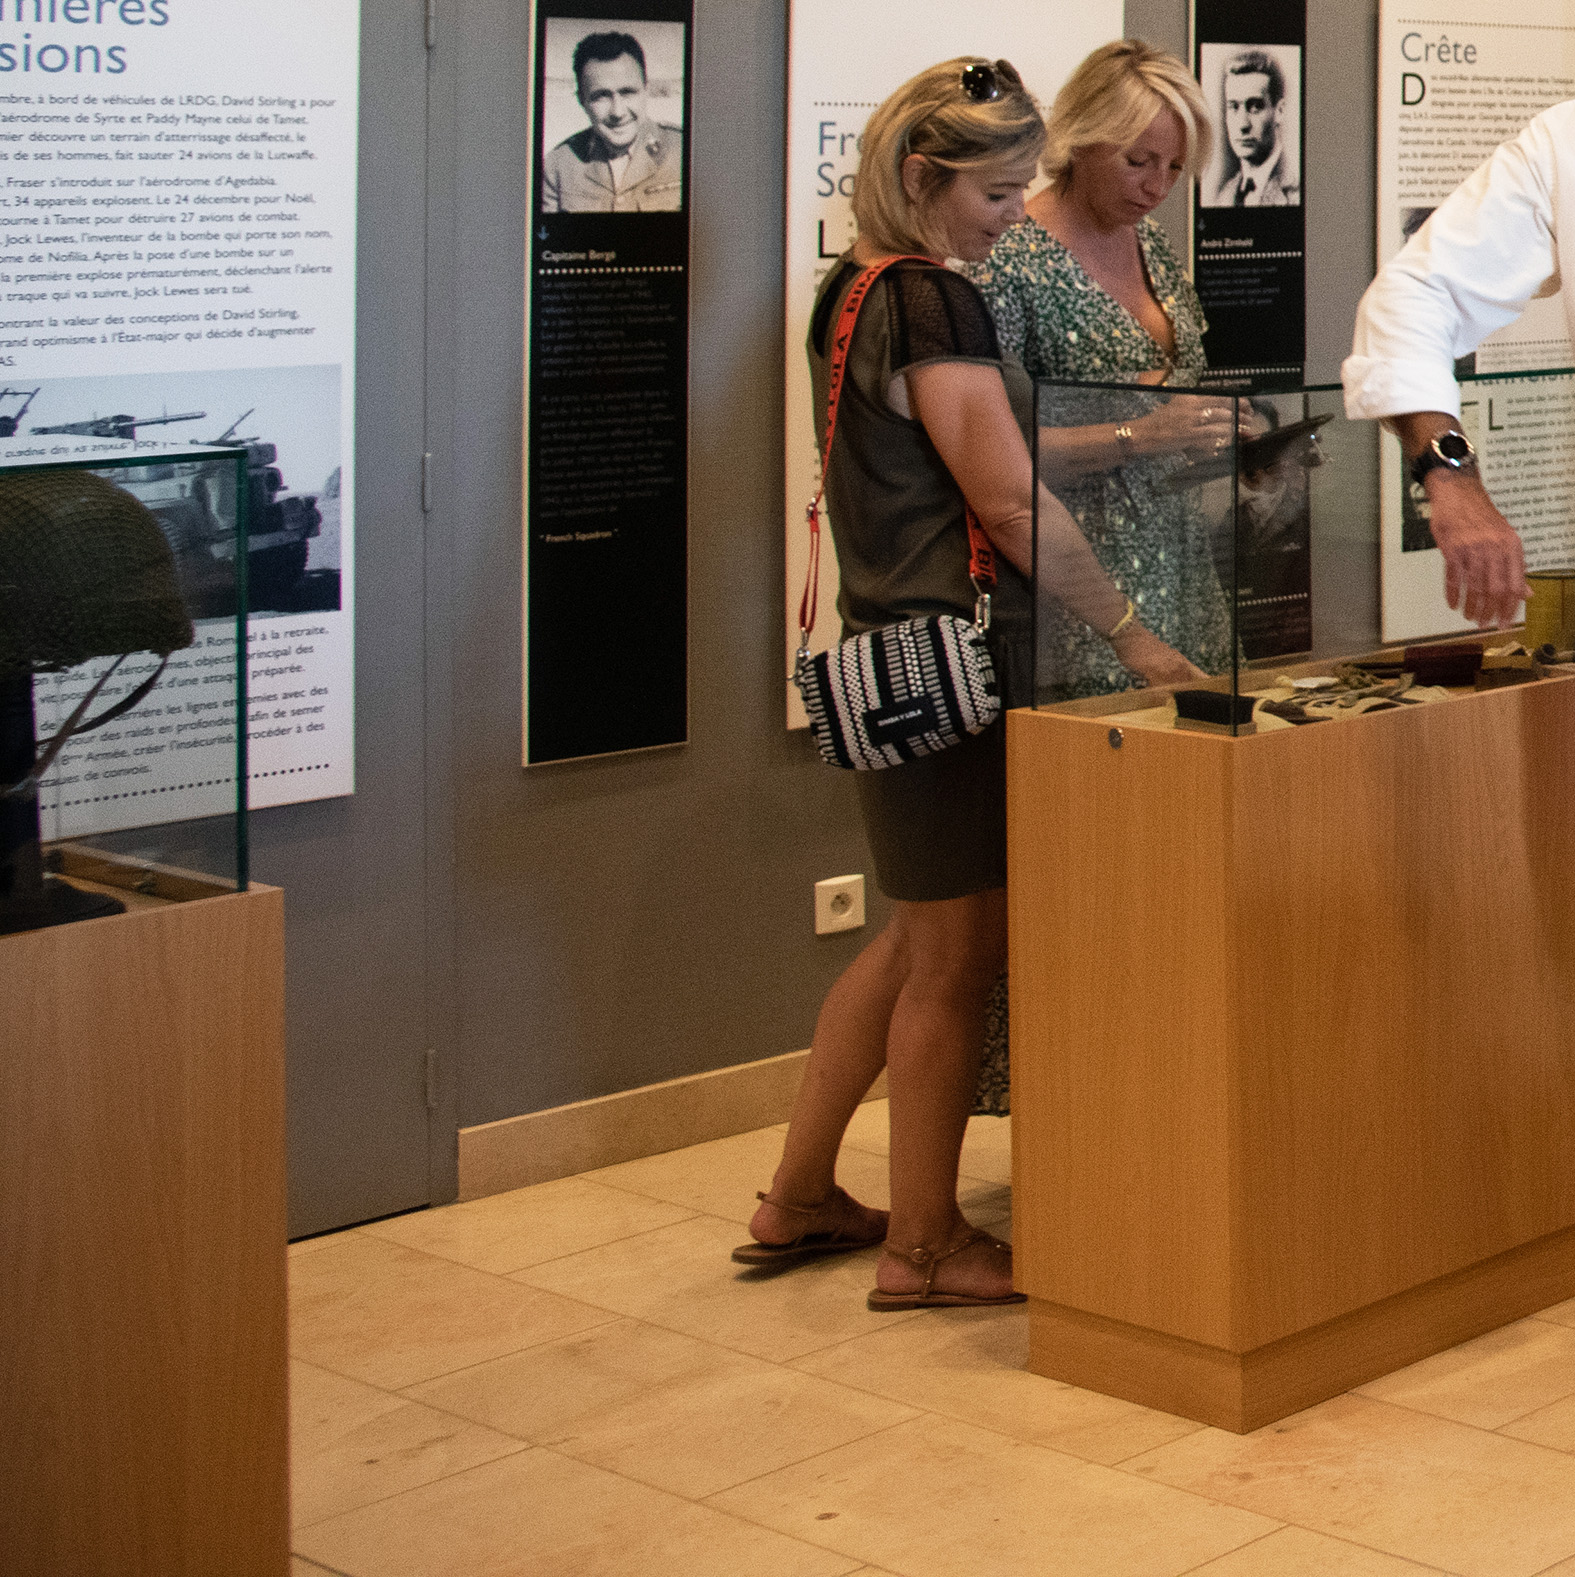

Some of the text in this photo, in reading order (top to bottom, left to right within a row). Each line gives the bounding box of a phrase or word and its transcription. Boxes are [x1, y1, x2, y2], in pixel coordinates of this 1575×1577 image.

[0, 33, 127, 74] sions
[1400, 32, 1478, 65] Crête
[37, 95, 44, 104] à
[49, 95, 79, 104] bord
[83, 96, 98, 104] de
[103, 96, 156, 105] véhicules
[160, 96, 175, 105] de
[179, 96, 220, 106] LRDG,
[222, 96, 254, 105] David
[258, 97, 296, 108] Stirling
[310, 99, 336, 108] pour
[75, 113, 309, 126] de Syrte et Paddy Mayne celui de Tamet.
[28, 132, 86, 141] découvre
[110, 132, 150, 141] terrain
[155, 131, 231, 144] d'atterrissage
[235, 133, 294, 142] désaffecté,
[296, 133, 306, 142] le
[14, 151, 29, 160] de
[57, 151, 112, 160] hommes,
[115, 151, 133, 160] fait
[138, 152, 173, 160] sauter
[179, 150, 193, 159] 24
[197, 151, 232, 159] avions
[236, 151, 251, 159] de
[254, 151, 263, 159] la
[268, 150, 318, 160] Lutwaffe.
[14, 194, 316, 208] 34 appareils explosent. Le 24 décembre pour Noël,
[4, 235, 32, 246] Jock
[36, 235, 78, 243] Lewes,
[81, 233, 143, 242] l'inventeur
[147, 233, 162, 241] de
[166, 233, 176, 241] la
[180, 232, 220, 240] bombe
[225, 232, 241, 242] qui
[246, 231, 277, 241] porte
